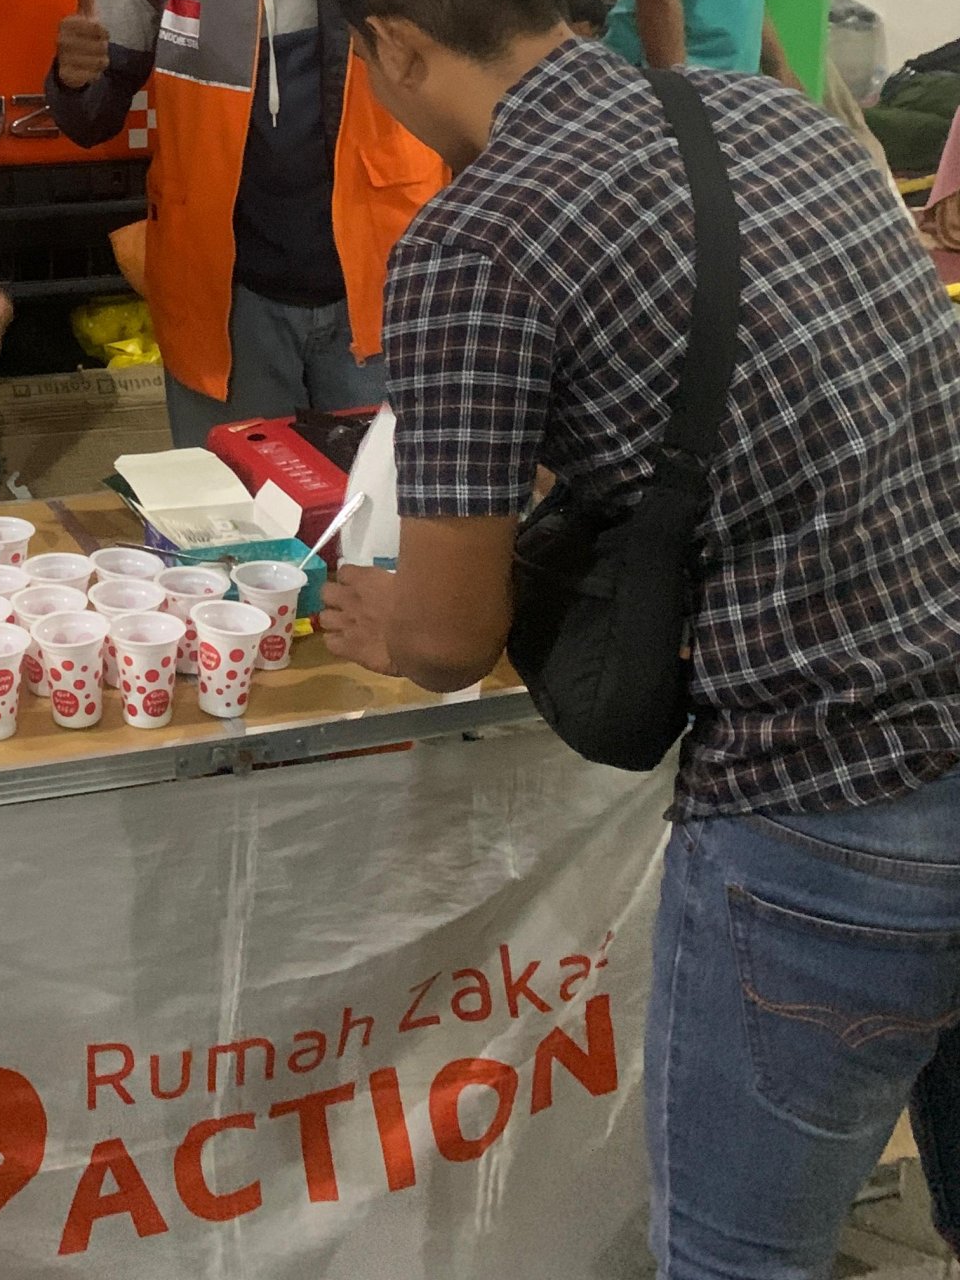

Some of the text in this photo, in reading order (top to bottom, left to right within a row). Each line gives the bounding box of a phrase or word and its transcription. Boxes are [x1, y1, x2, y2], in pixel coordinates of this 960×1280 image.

[116, 376, 164, 393] putih
[85, 1007, 375, 1110] Rumah
[57, 992, 620, 1255] ACTION
